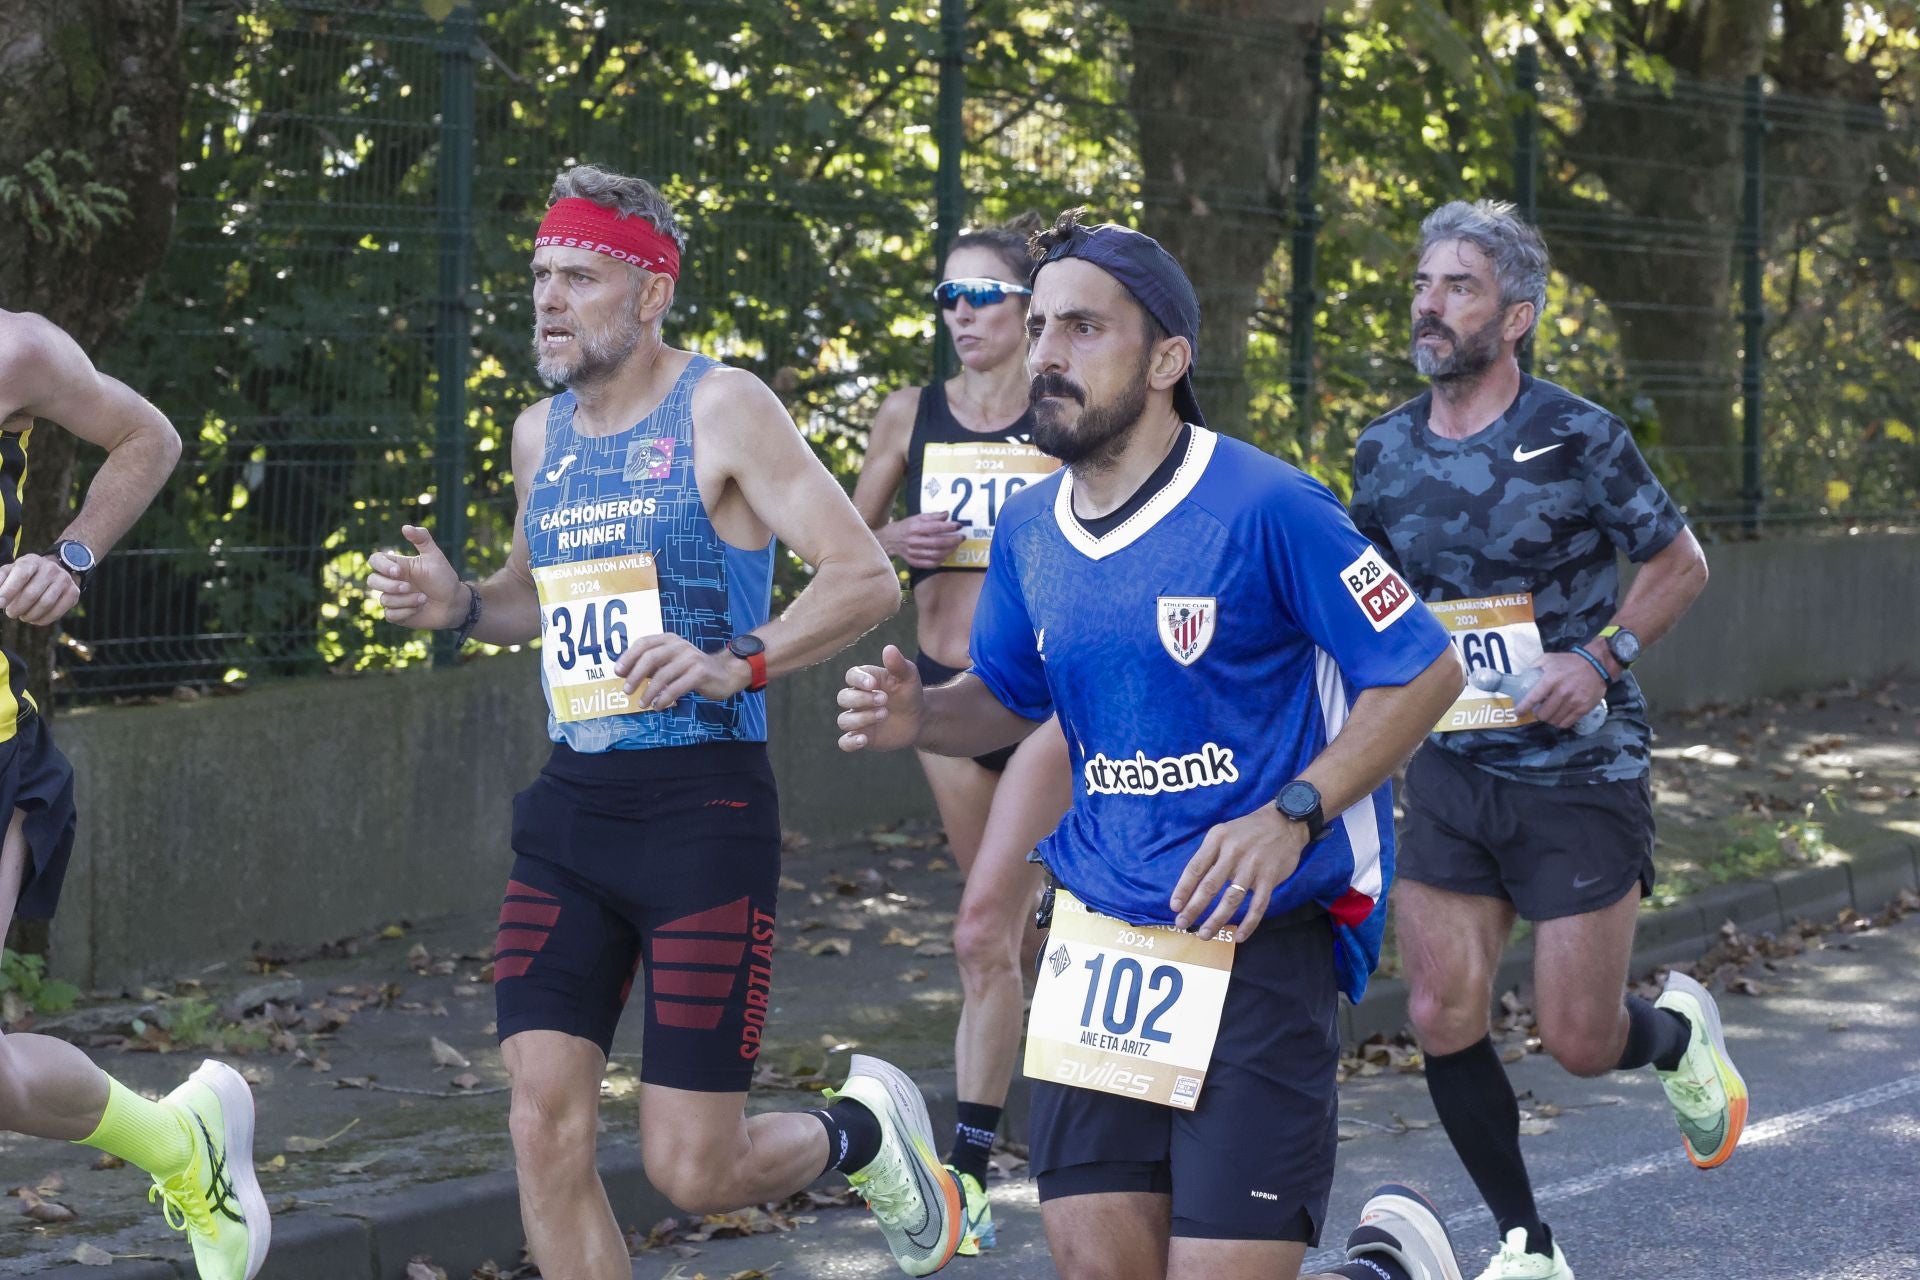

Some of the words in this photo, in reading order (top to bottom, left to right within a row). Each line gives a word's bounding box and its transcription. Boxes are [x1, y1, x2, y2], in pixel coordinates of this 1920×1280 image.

[535, 236, 655, 269] PRESSPORT
[975, 460, 1004, 470] 2024
[540, 497, 657, 531] CACHONEROS
[558, 523, 626, 550] RUNNER
[573, 559, 617, 576] MARATÓN
[618, 554, 653, 570] AVILÉS
[570, 579, 600, 595] 2024
[1368, 580, 1405, 616] PAY.
[1494, 594, 1529, 608] AVILÉS
[1455, 614, 1479, 626] 2024
[552, 598, 628, 671] 346
[1173, 641, 1198, 661] BILBAO
[1451, 631, 1513, 682] 60
[585, 667, 605, 681] TALA
[570, 687, 630, 715] avilés
[1116, 929, 1155, 950] 2024
[739, 907, 776, 1060] SPORTLAST
[1080, 953, 1184, 1044] 102
[1080, 1030, 1099, 1048] ANE
[1099, 1033, 1119, 1051] ETA
[1120, 1039, 1152, 1057] ARITZ
[1055, 1058, 1155, 1096] avilés
[1251, 1189, 1278, 1201] KIPRUN
